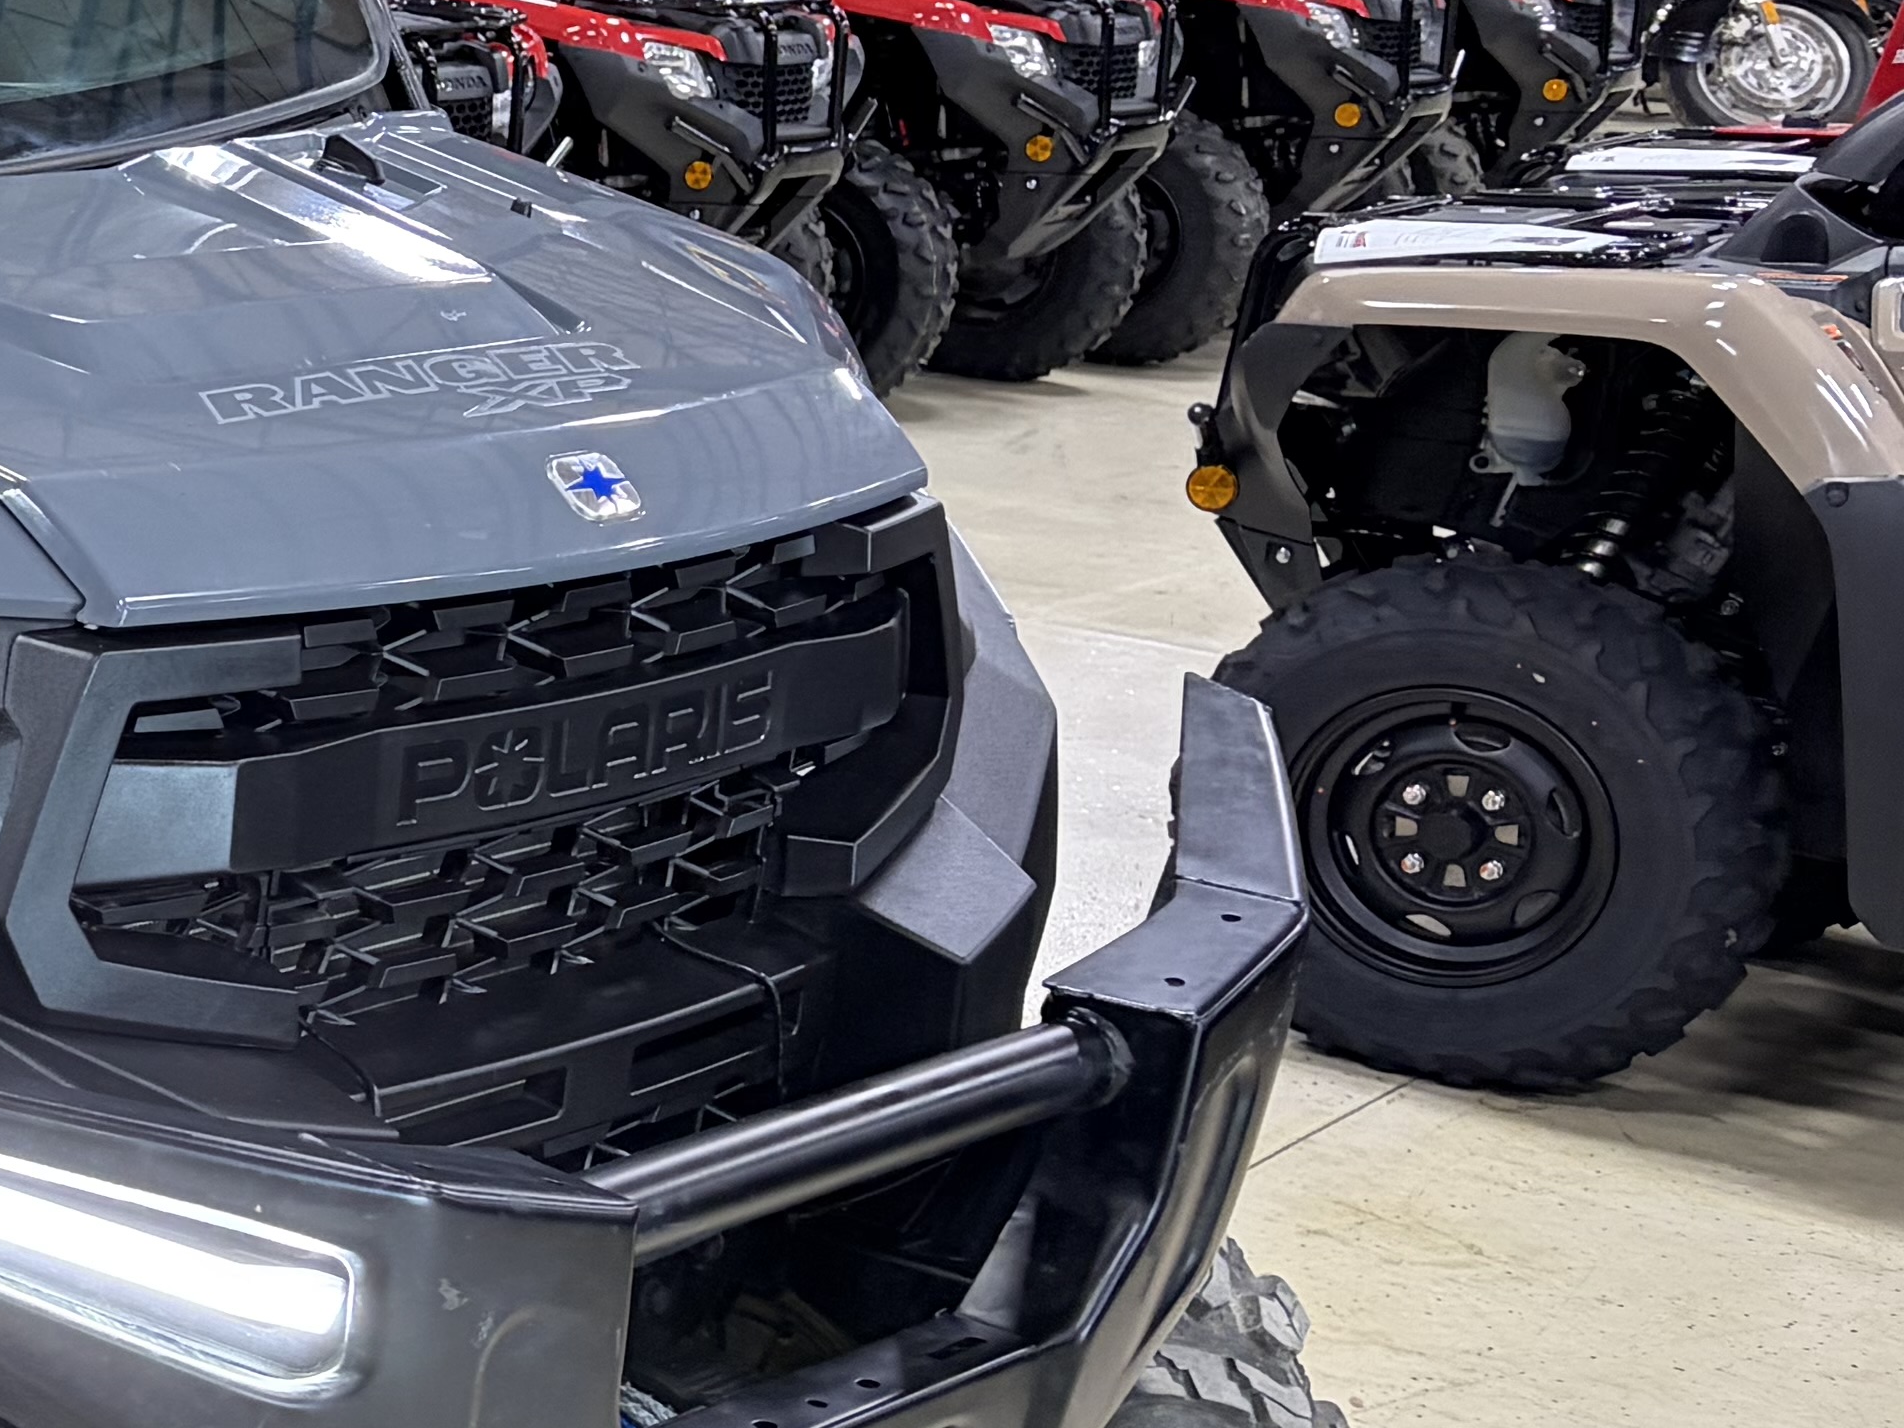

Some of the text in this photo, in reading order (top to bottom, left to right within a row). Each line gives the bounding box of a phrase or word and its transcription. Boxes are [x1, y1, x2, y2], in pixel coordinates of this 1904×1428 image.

[198, 342, 641, 425] RANGER
[456, 372, 632, 419] XP
[395, 669, 775, 828] POLARIS
